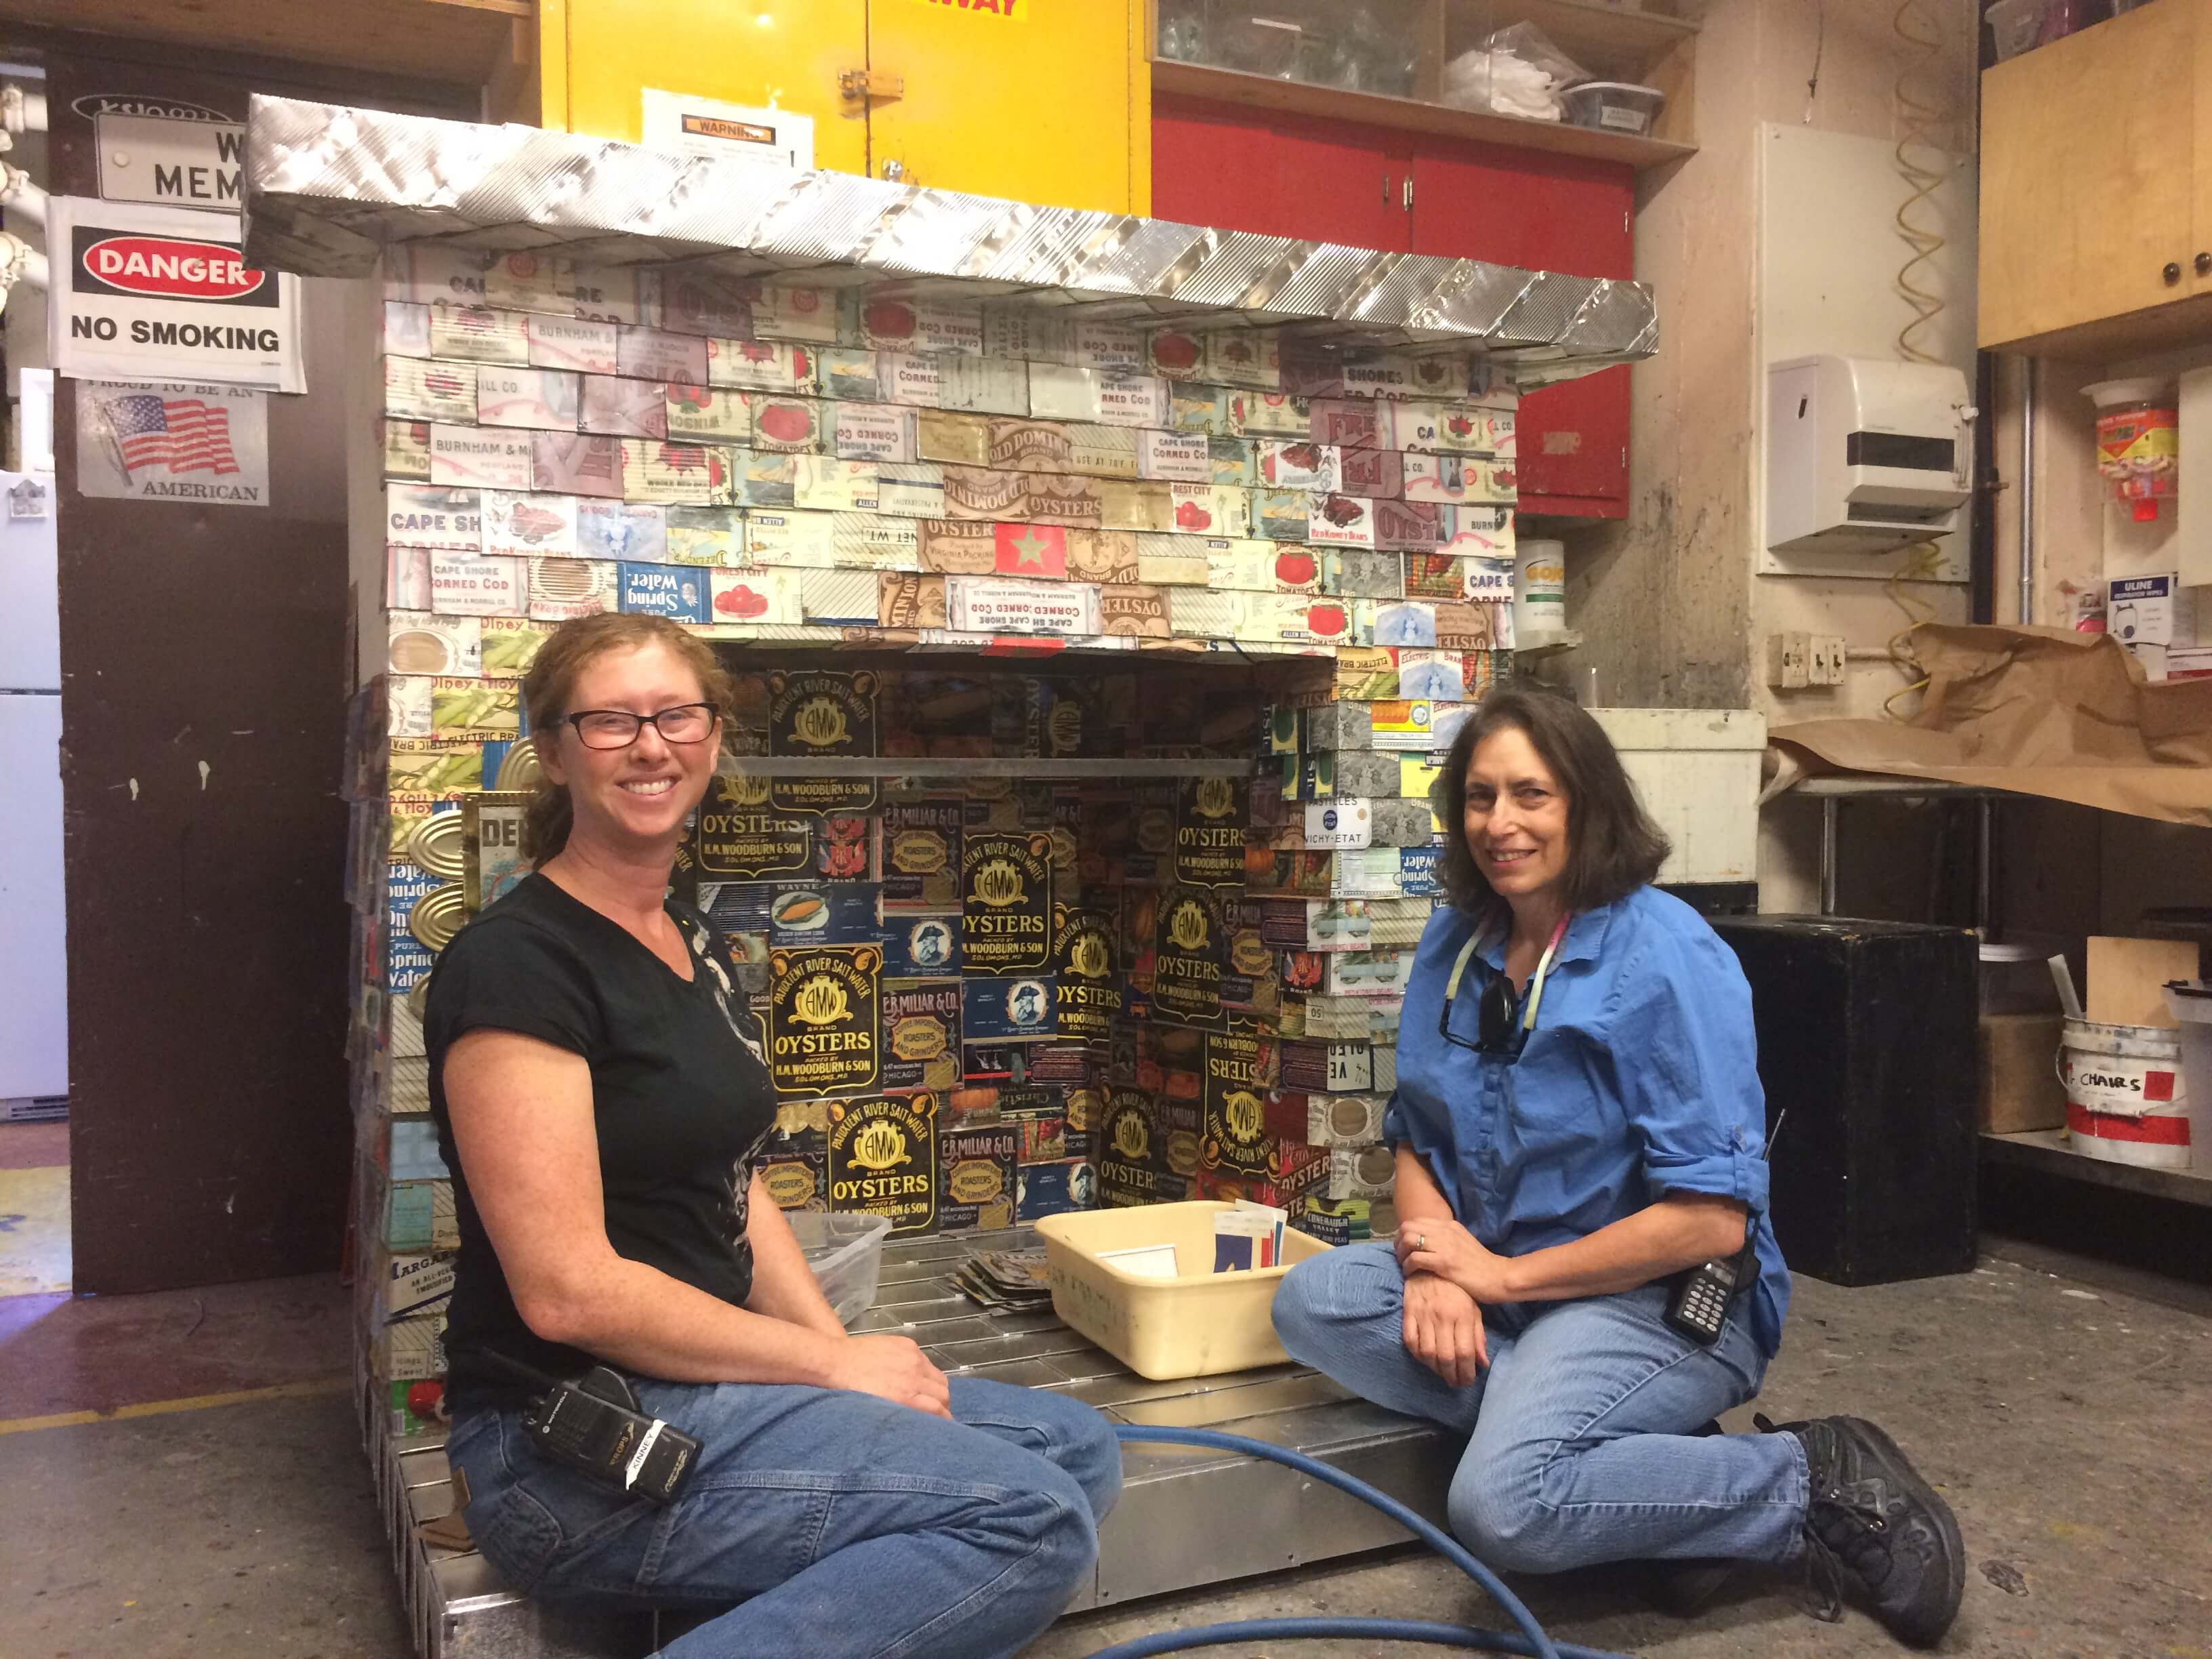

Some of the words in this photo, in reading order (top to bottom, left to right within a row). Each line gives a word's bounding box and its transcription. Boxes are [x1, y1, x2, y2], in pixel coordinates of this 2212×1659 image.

[98, 248, 251, 287] DANGER
[71, 314, 117, 342] NO
[130, 319, 280, 352] SMOKING
[538, 324, 600, 340] BURNHAM
[227, 387, 254, 398] AN
[1118, 383, 1143, 392] SHORE
[436, 440, 501, 455] BURNHAM
[505, 444, 516, 455] &
[1158, 438, 1180, 447] CAPE
[1181, 438, 1206, 448] SHORE
[988, 441, 1013, 462] OLD
[1020, 445, 1054, 457] BRAND
[1152, 447, 1189, 460] CORNED
[142, 480, 260, 501] AMERICAN
[1030, 495, 1102, 516] OYSTERS
[390, 512, 447, 532] CAPE
[865, 529, 890, 541] WT.
[1349, 531, 1368, 541] BEANS
[434, 565, 462, 576] CAPE
[464, 566, 499, 577] SHORE
[483, 577, 510, 590] COD
[626, 572, 678, 590] Water.
[1469, 575, 1502, 588] CAPE
[2125, 580, 2154, 592] ULINE
[628, 586, 678, 612] Spring
[970, 603, 993, 614] COD
[1031, 605, 1080, 617] CORNED
[979, 615, 1008, 625] SHORE
[1010, 617, 1030, 626] CAPE
[1052, 617, 1073, 626] CAPE
[1357, 656, 1389, 669] ELECTRIC
[806, 679, 830, 695] RIVER
[830, 680, 850, 699] SALT
[847, 695, 871, 724] WATER
[792, 782, 844, 795] WOODBURN
[852, 783, 870, 795] SON
[901, 806, 938, 825] MILLAR
[1178, 826, 1247, 847] OYSTERS
[720, 842, 776, 856] WOODBURN
[783, 843, 802, 855] SON
[984, 842, 1009, 857] RIVER
[1008, 843, 1027, 861] SALT
[1025, 852, 1046, 884] WATER
[1403, 855, 1437, 868] Water.
[1401, 871, 1437, 886] Spring
[777, 882, 820, 892] WAYNE
[969, 942, 1019, 954] WOODBURN
[1026, 941, 1044, 954] SON
[1158, 954, 1220, 982] OYSTERS
[805, 957, 833, 972] RIVER
[832, 958, 852, 978] SALT
[849, 972, 872, 1000] WATER
[900, 995, 936, 1012] MILLAR
[1311, 1007, 1322, 1018] 50
[775, 1031, 872, 1055] OYSTERS
[903, 1031, 935, 1042] ROASTERS
[1210, 1037, 1223, 1050] SON
[896, 1041, 909, 1056] AND
[909, 1038, 946, 1057] GRINDERS
[792, 1061, 844, 1076] WOODBURN
[852, 1059, 872, 1073] SON
[1329, 1061, 1348, 1079] VE
[2080, 1072, 2142, 1092] CHAIRS
[863, 1101, 889, 1118] RIVER
[889, 1102, 909, 1122] SALT
[905, 1113, 929, 1143] WATER
[958, 1136, 994, 1156] MILLAR
[1234, 1148, 1256, 1165] RIVER
[867, 1169, 897, 1177] BRAND
[960, 1174, 992, 1185] ROASTERS
[770, 1179, 804, 1189] ROASTERS
[833, 1174, 930, 1200] OYSTERS
[910, 1202, 928, 1214] SON
[548, 1391, 569, 1425] MOTOROLA
[609, 1434, 630, 1466] PROPS
[633, 1433, 654, 1470] KINNEY
